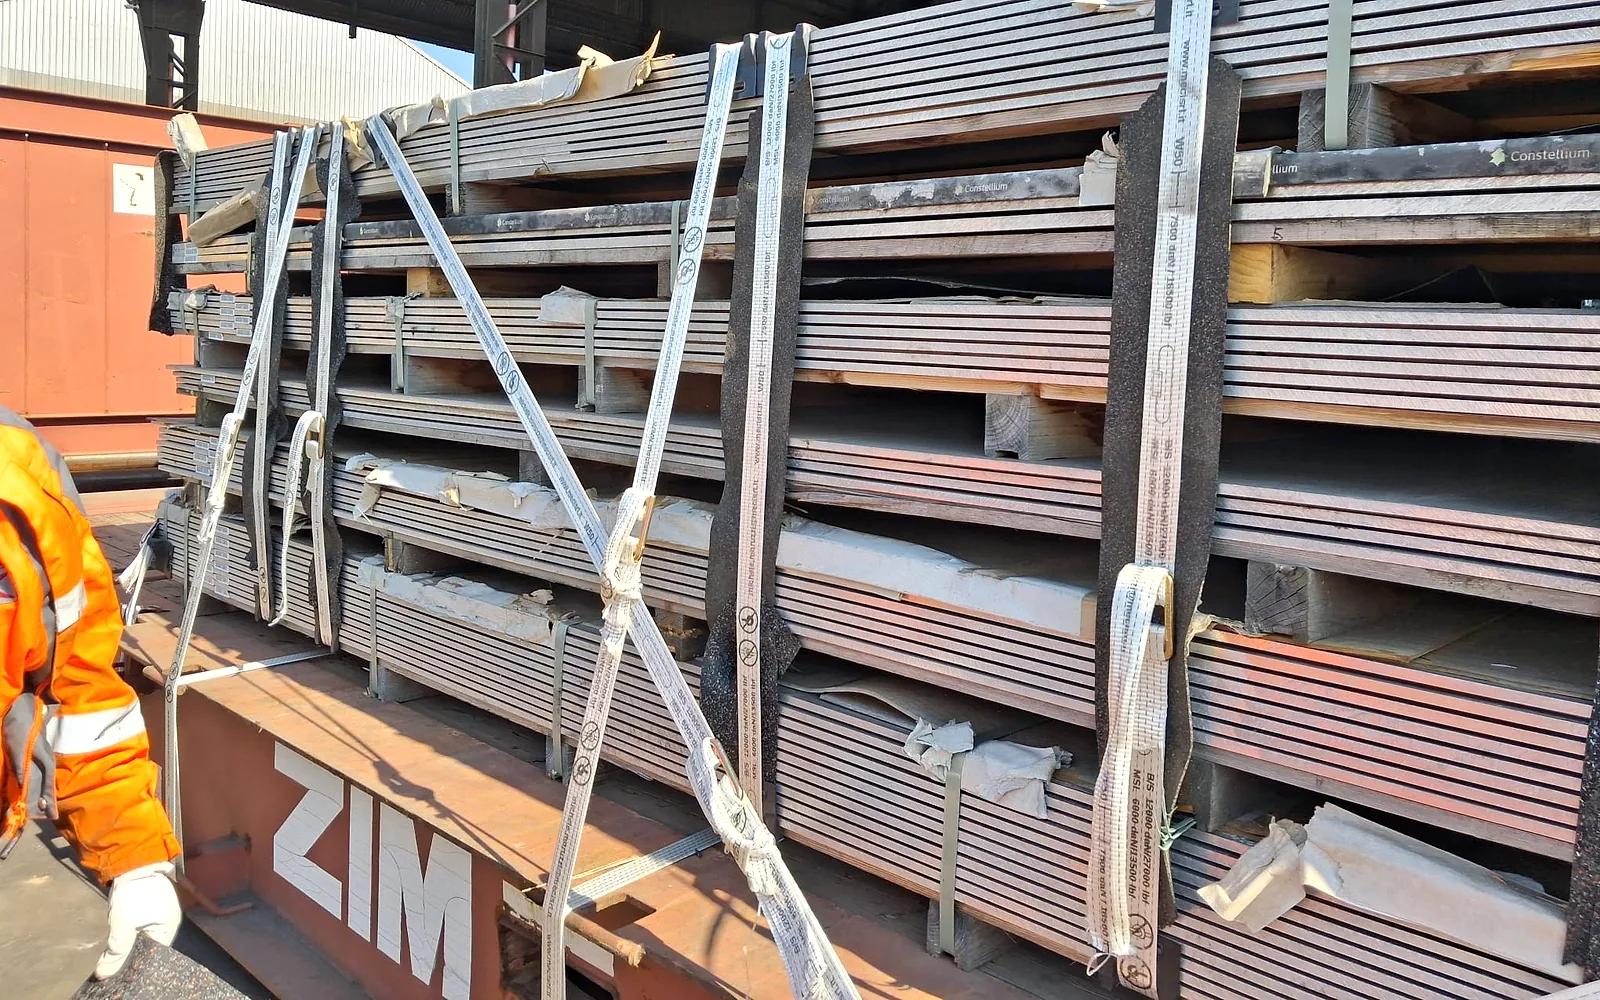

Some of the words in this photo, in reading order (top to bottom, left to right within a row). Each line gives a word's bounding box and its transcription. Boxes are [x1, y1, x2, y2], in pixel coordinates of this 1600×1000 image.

[1174, 136, 1185, 168] W50
[1511, 148, 1590, 162] Constellium
[964, 182, 1008, 193] Constellium
[1170, 215, 1178, 241] 7500
[1164, 312, 1173, 327] lbf
[581, 521, 596, 541] W50
[1132, 768, 1141, 792] MSL
[1147, 773, 1155, 792] B/S
[1132, 798, 1140, 824] 6000
[1144, 798, 1154, 829] 12000
[1130, 826, 1139, 882] daN/13500
[1142, 831, 1152, 888] daN/27000
[274, 740, 472, 1000] ZIM
[1128, 884, 1137, 899] lbf
[1141, 890, 1150, 905] lbf
[788, 935, 801, 953] B/S
